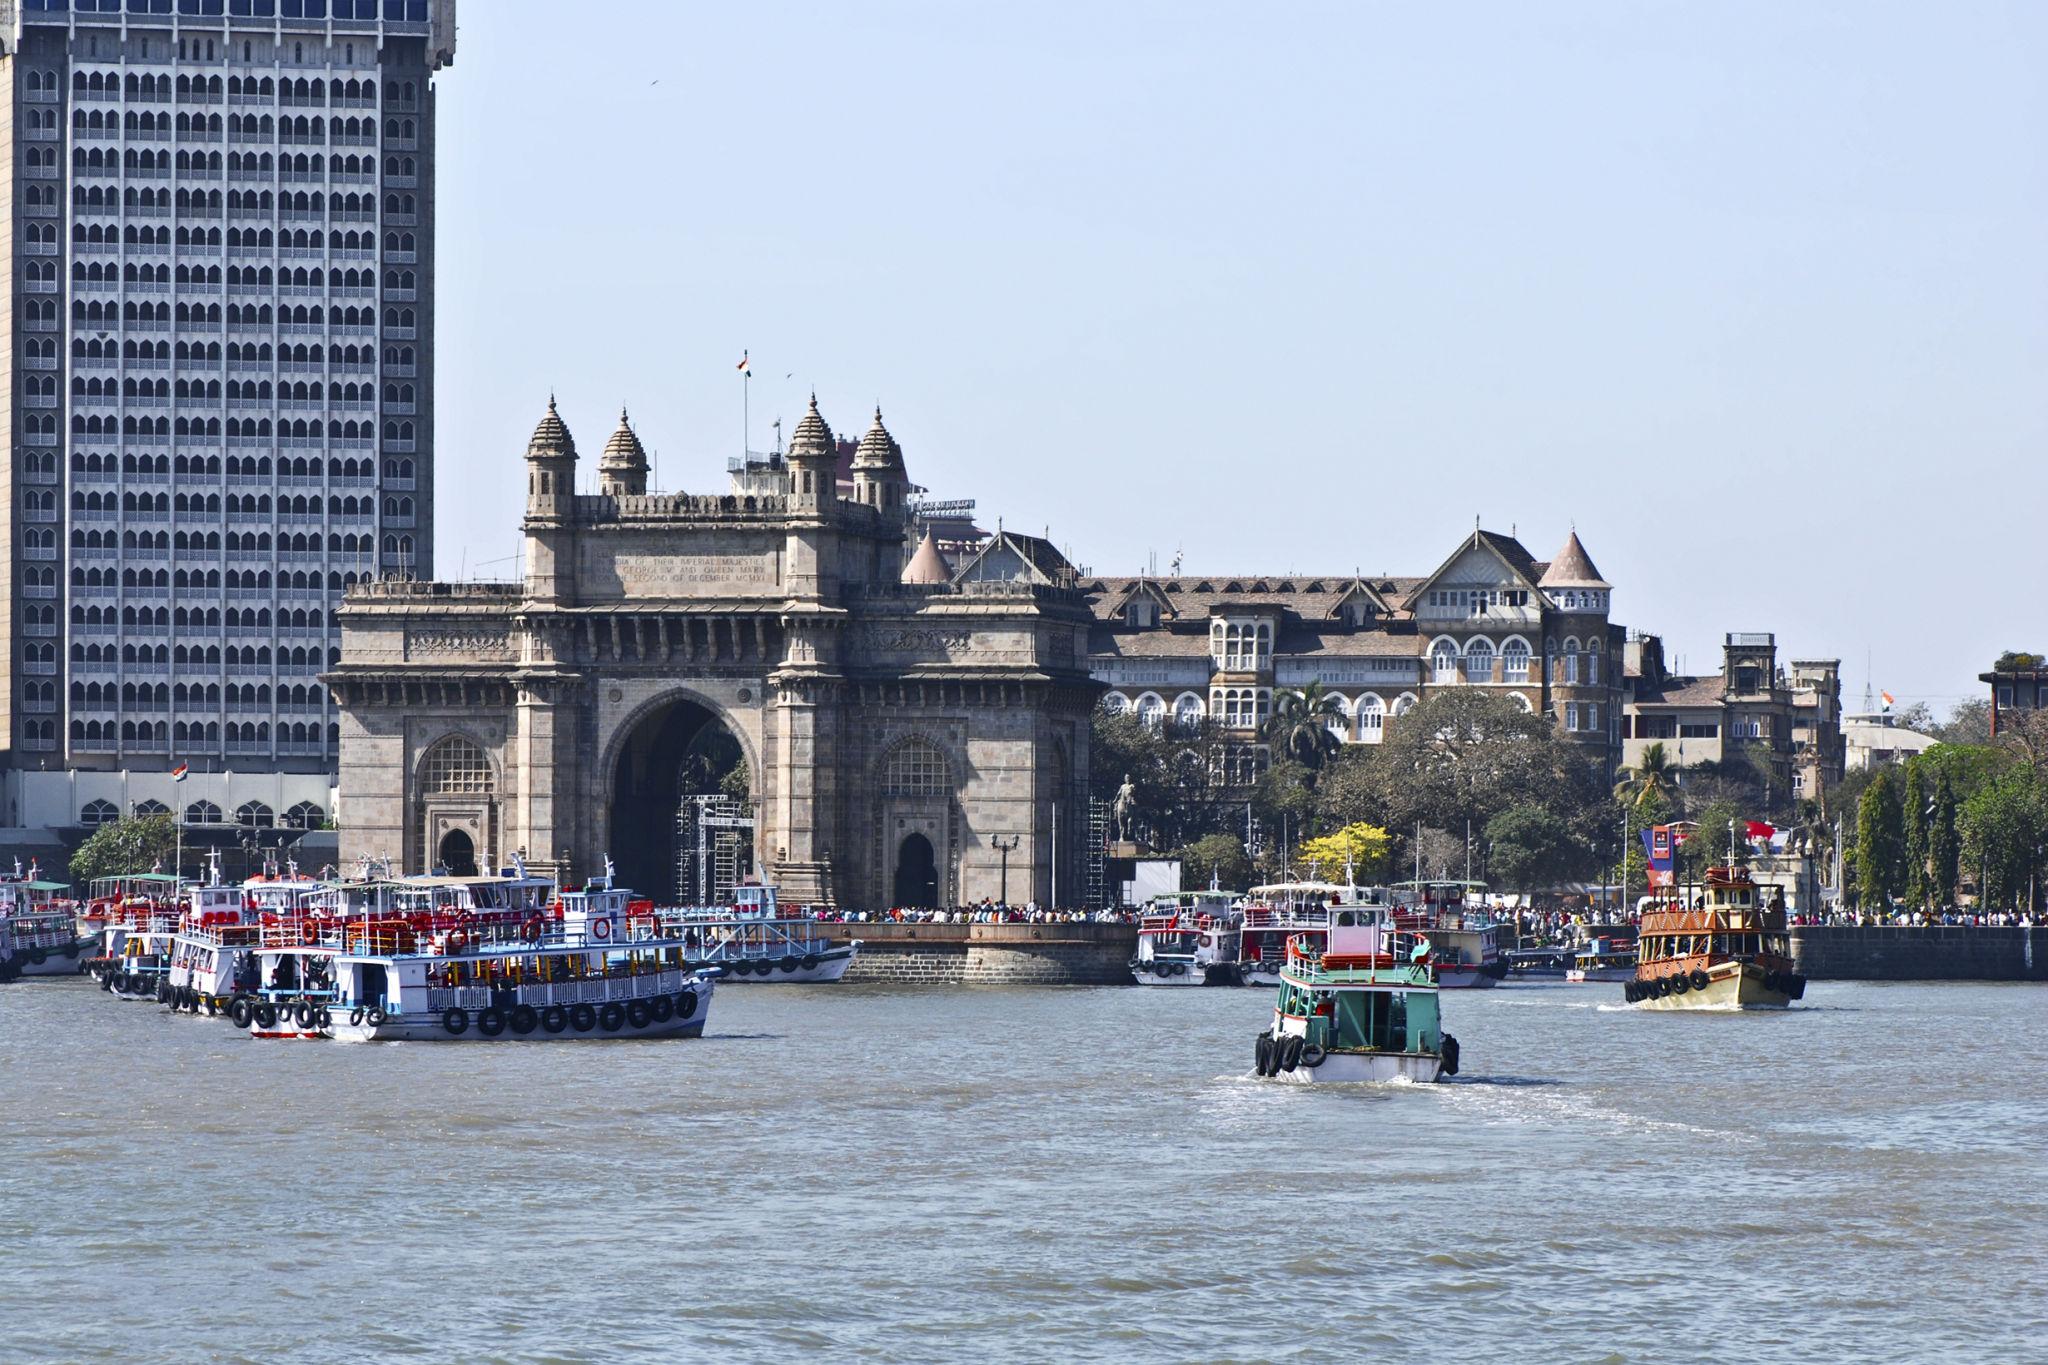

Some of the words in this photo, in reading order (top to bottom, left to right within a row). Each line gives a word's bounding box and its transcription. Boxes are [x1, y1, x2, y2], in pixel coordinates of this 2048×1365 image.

[623, 566, 656, 574] GEORGE
[680, 566, 696, 574] AND
[704, 566, 734, 574] QUEEN
[740, 566, 765, 574] MARY
[633, 574, 667, 582] SECOND
[688, 574, 730, 582] DECEMBER
